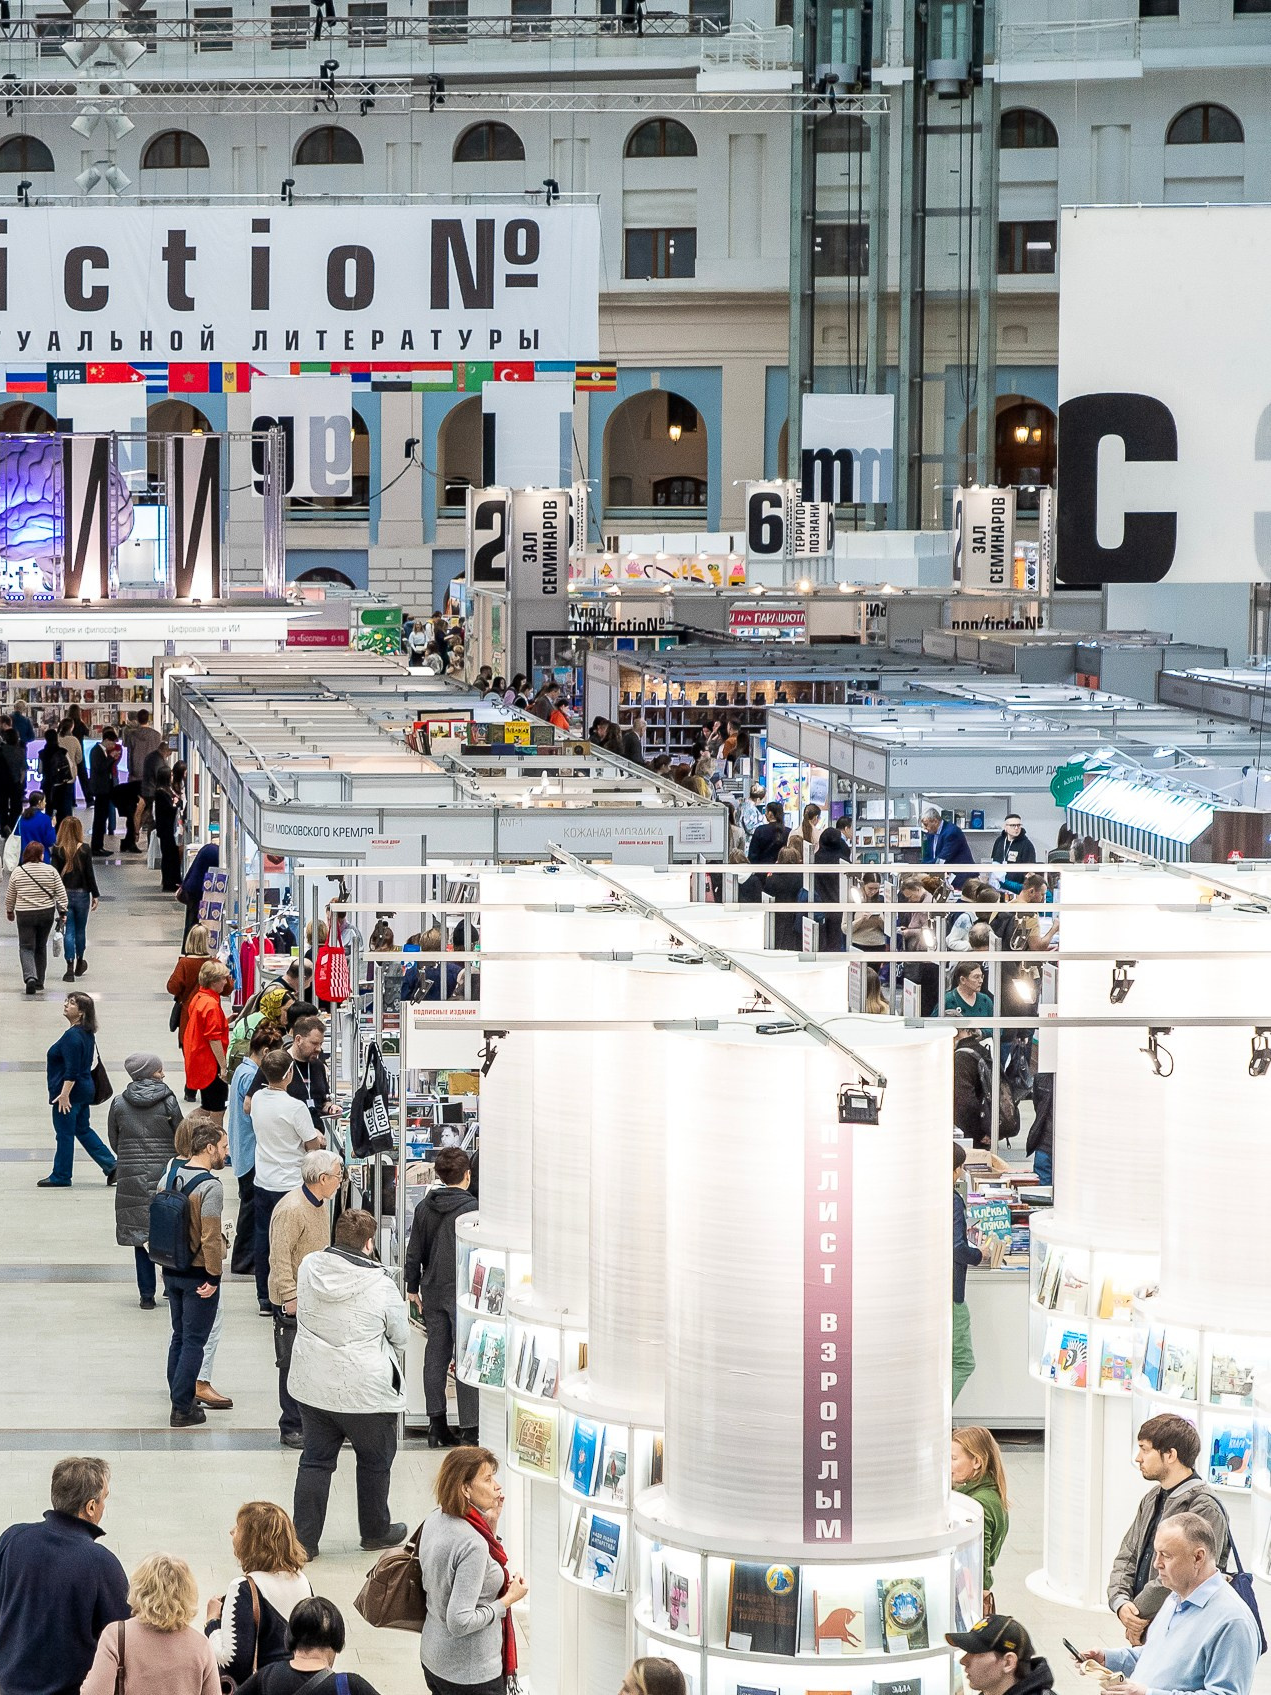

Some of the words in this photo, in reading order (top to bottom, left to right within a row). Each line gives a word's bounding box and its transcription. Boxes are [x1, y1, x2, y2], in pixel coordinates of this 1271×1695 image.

[252, 329, 540, 351] ЛИТЕРАТУРЫ
[749, 492, 783, 554] 6
[809, 503, 820, 553] ПОЗНАНИ
[474, 500, 506, 581] 2
[523, 531, 538, 563] ЗАЛ
[542, 500, 558, 595] СЕМИНАРОВ
[972, 525, 987, 554] ЗАЛ
[989, 497, 1006, 584] СЕМИНАРОВ
[45, 625, 75, 635] История
[84, 625, 128, 635] философия
[168, 624, 205, 634] Цифровая
[228, 624, 241, 633] ИИ
[995, 765, 1044, 775] ВЛАДИМИР
[1045, 765, 1058, 776] ДА
[276, 824, 330, 838] МОСКОВСКОГО
[332, 827, 374, 838] КРЕМЛЯ
[563, 828, 612, 838] КОЖАНАЯ
[817, 1123, 839, 1284] П-ЛИСТ
[814, 1313, 842, 1539] ВЗРОСЛЫМ
